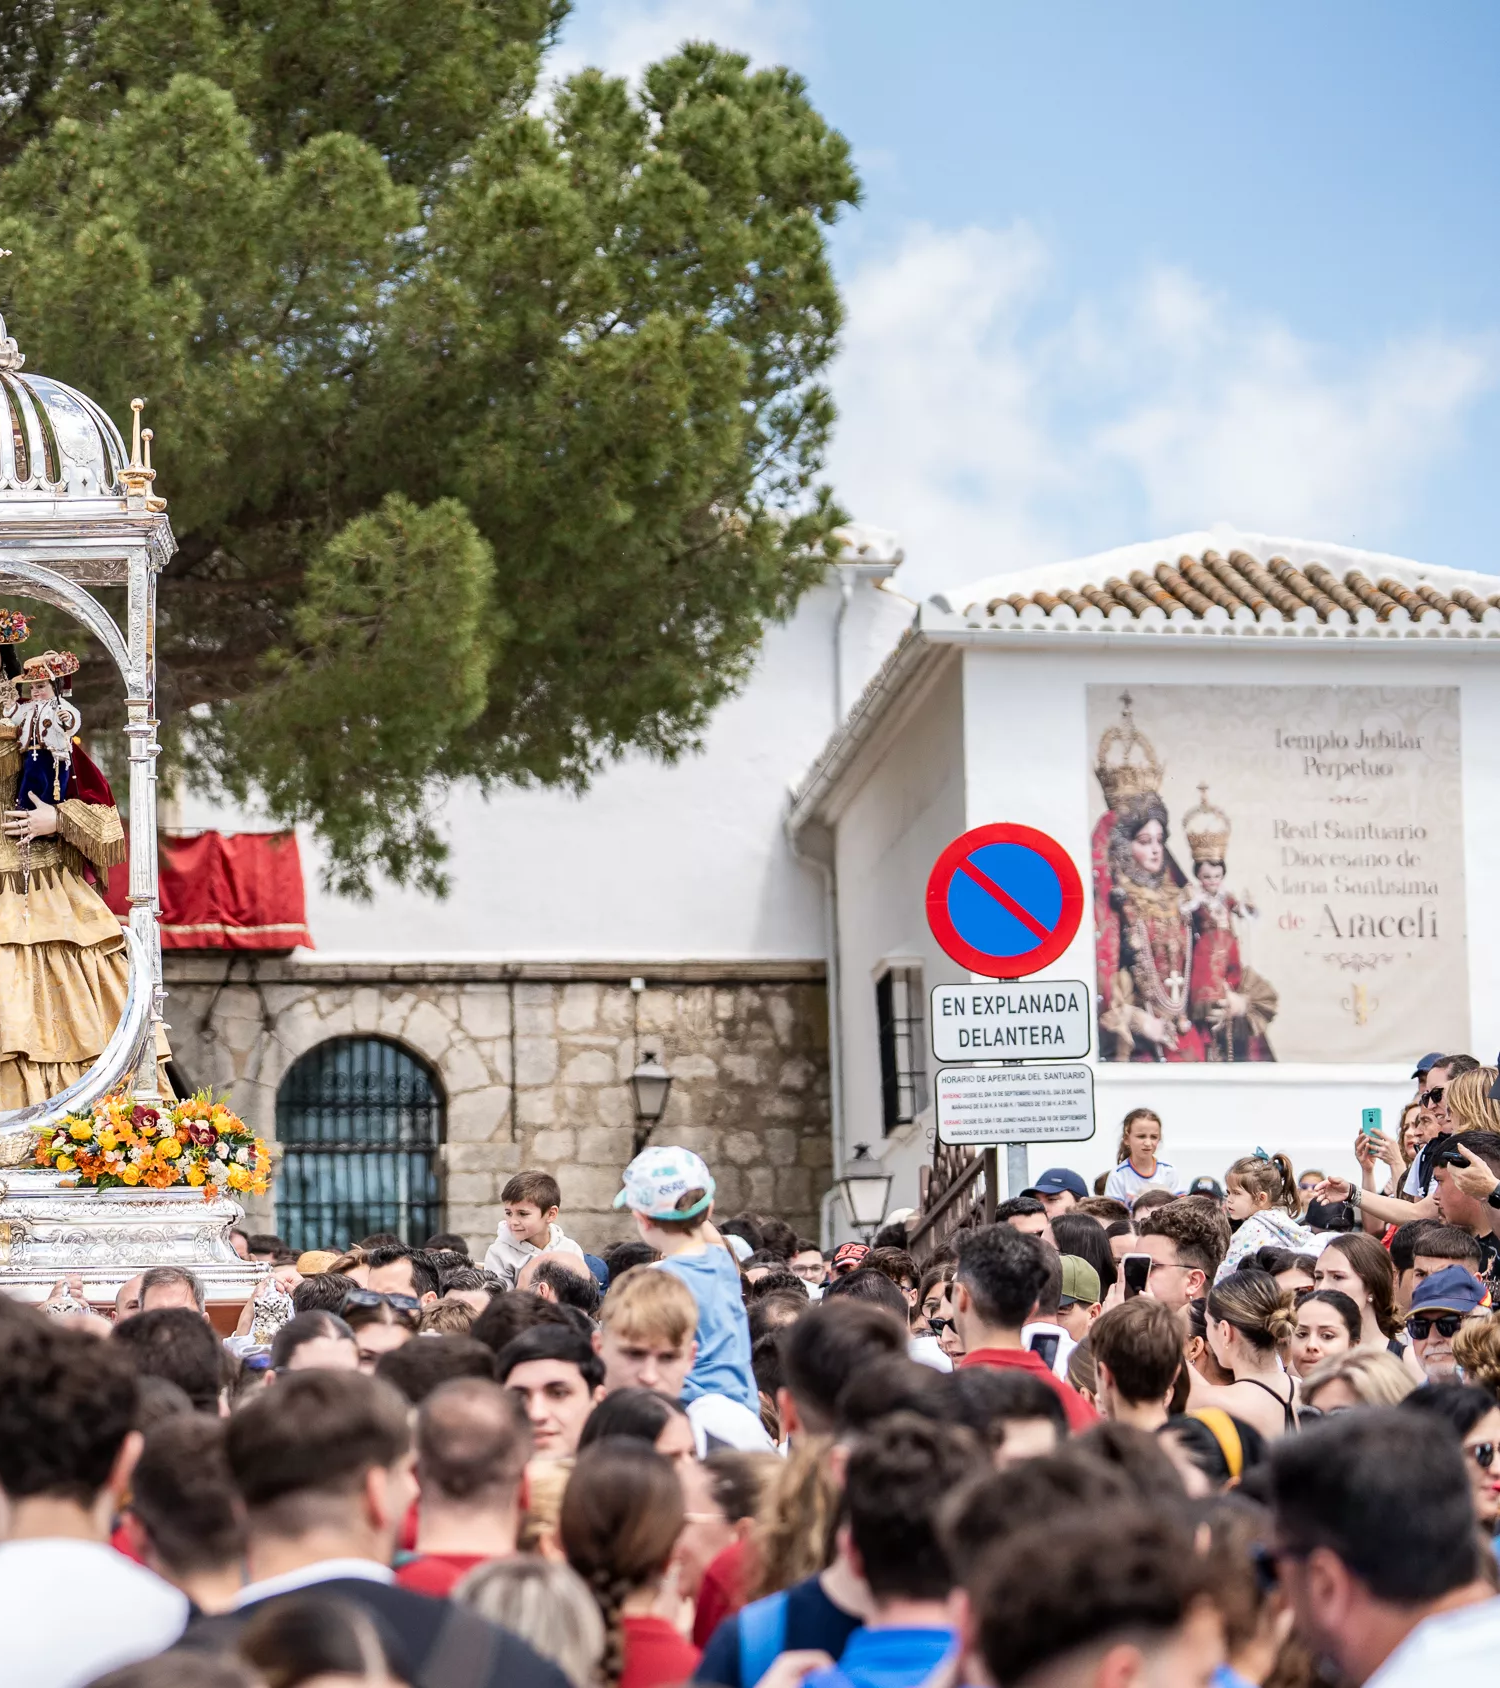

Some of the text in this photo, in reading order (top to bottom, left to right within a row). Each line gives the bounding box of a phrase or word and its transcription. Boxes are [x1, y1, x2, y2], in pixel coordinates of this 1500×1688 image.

[1275, 728, 1425, 753] Templo Jubilar
[1303, 755, 1394, 781] Perpetuo
[1272, 818, 1428, 840] Real Santuario
[1280, 846, 1421, 867] Diocesano de
[1278, 902, 1439, 938] de Araceli
[942, 992, 1080, 1017] EN EXPLANADA
[958, 1024, 1066, 1048] DELANTERA
[941, 1071, 1086, 1084] HORARIO DE APERTURA DEL SANTUARIO
